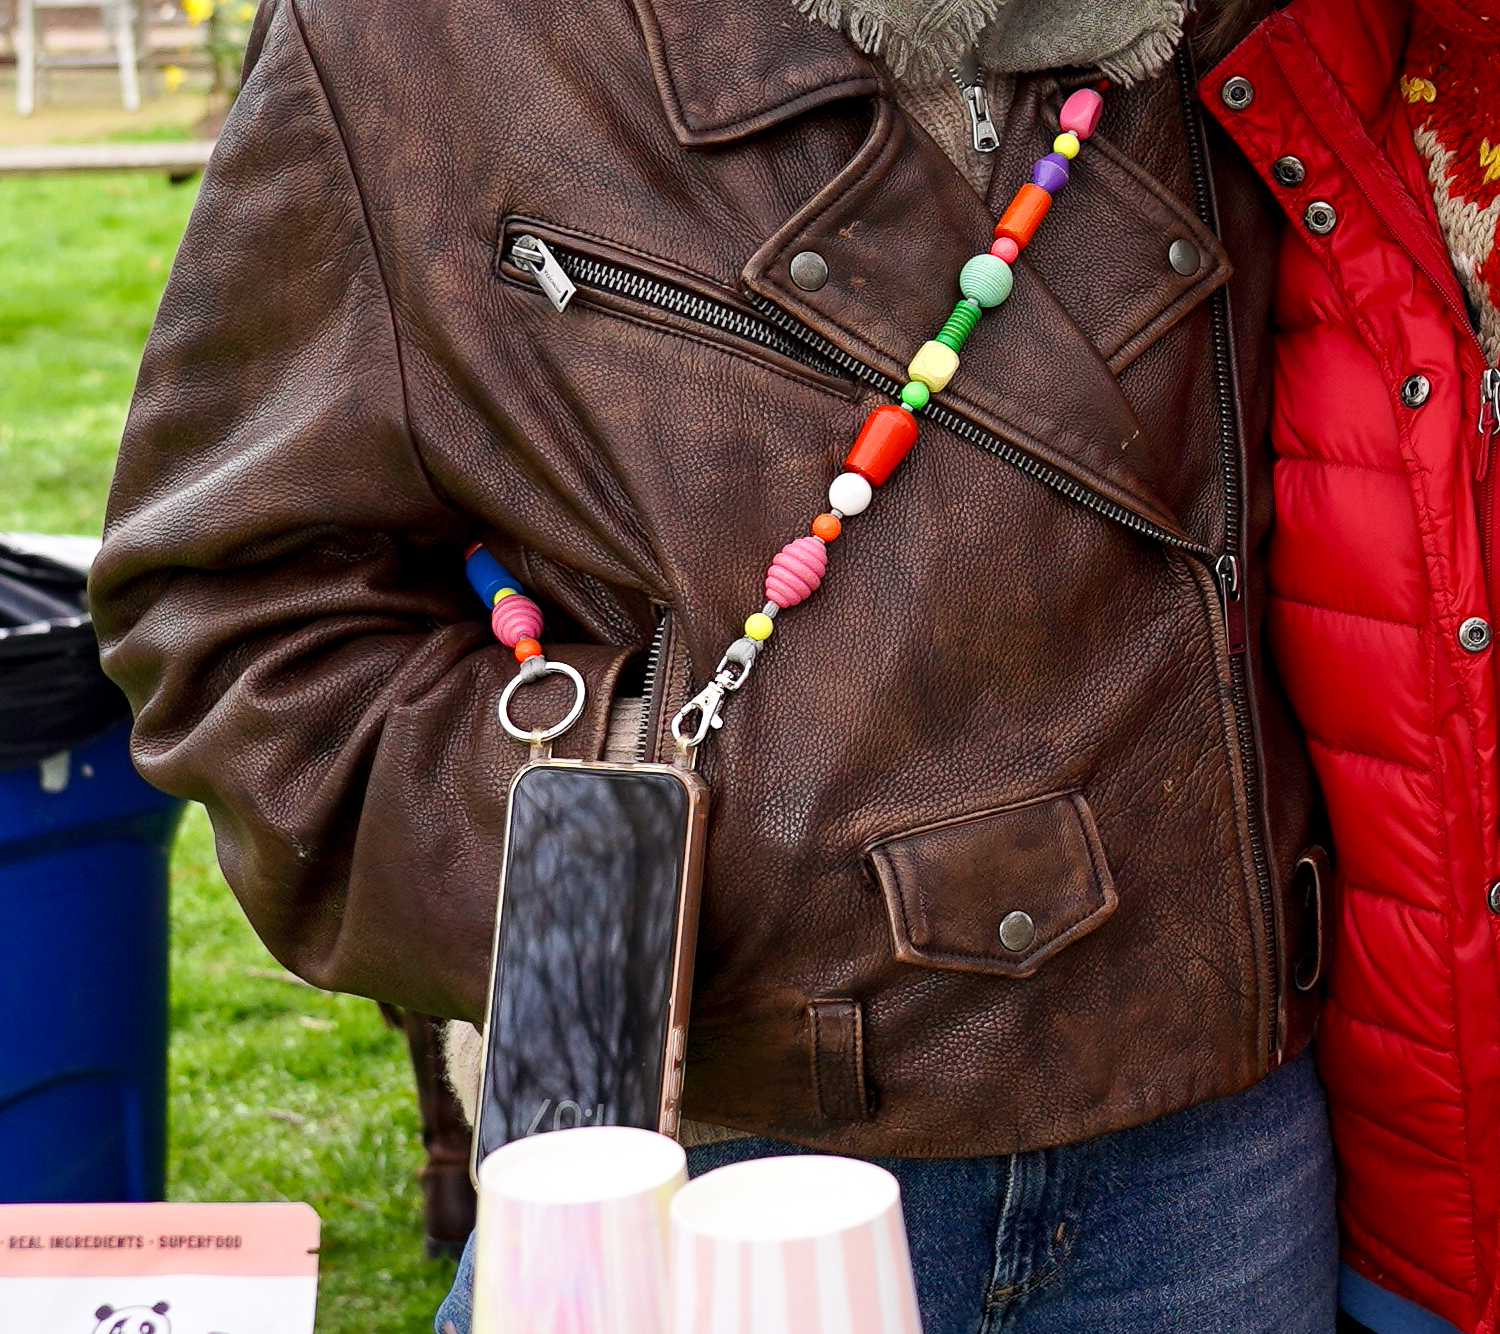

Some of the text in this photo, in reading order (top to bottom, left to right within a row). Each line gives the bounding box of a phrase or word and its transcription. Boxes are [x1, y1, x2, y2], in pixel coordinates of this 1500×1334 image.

[9, 1235, 46, 1250] REAL
[50, 1234, 145, 1249] INGREDIENTS
[158, 1234, 243, 1249] SUPERFOOD
